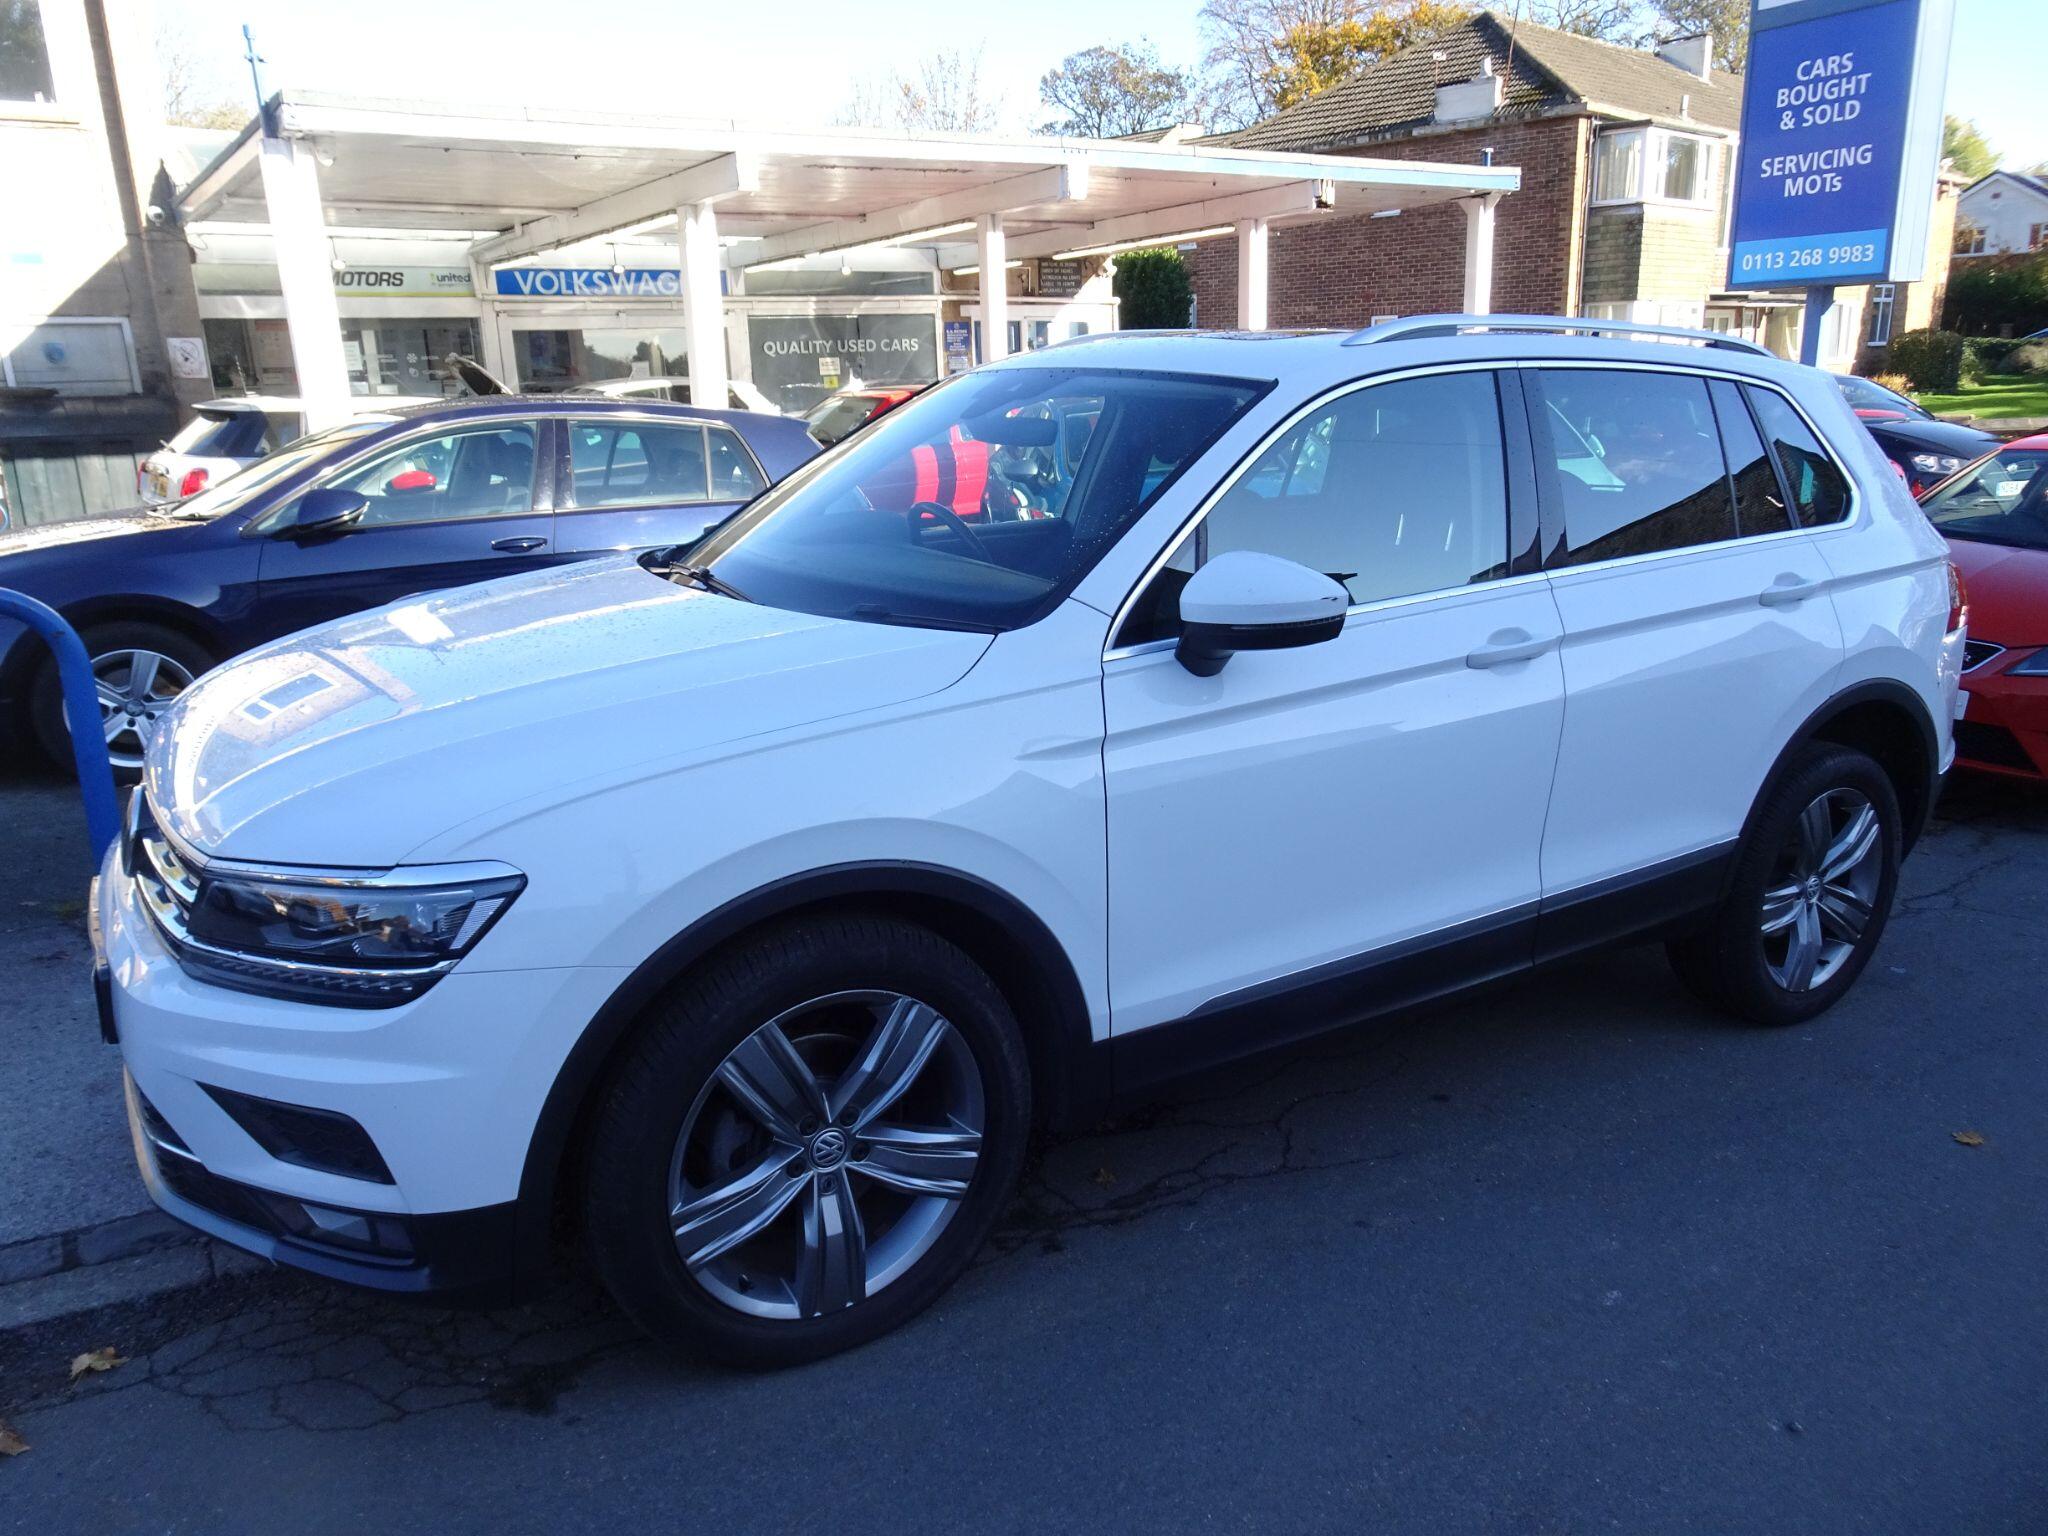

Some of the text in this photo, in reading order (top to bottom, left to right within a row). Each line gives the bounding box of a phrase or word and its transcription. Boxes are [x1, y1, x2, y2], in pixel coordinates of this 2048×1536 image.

[1796, 52, 1854, 81] CARS
[1776, 73, 1872, 109] BOUGHT
[1780, 100, 1861, 131] & SOLD
[1760, 144, 1873, 178] SERVICING
[1784, 172, 1842, 198] MOTs
[1742, 244, 1875, 271] 0113 268 9983
[436, 272, 471, 283] united
[513, 270, 680, 296] VOLKSWAG
[763, 338, 919, 357] QUALITY USED CARS
